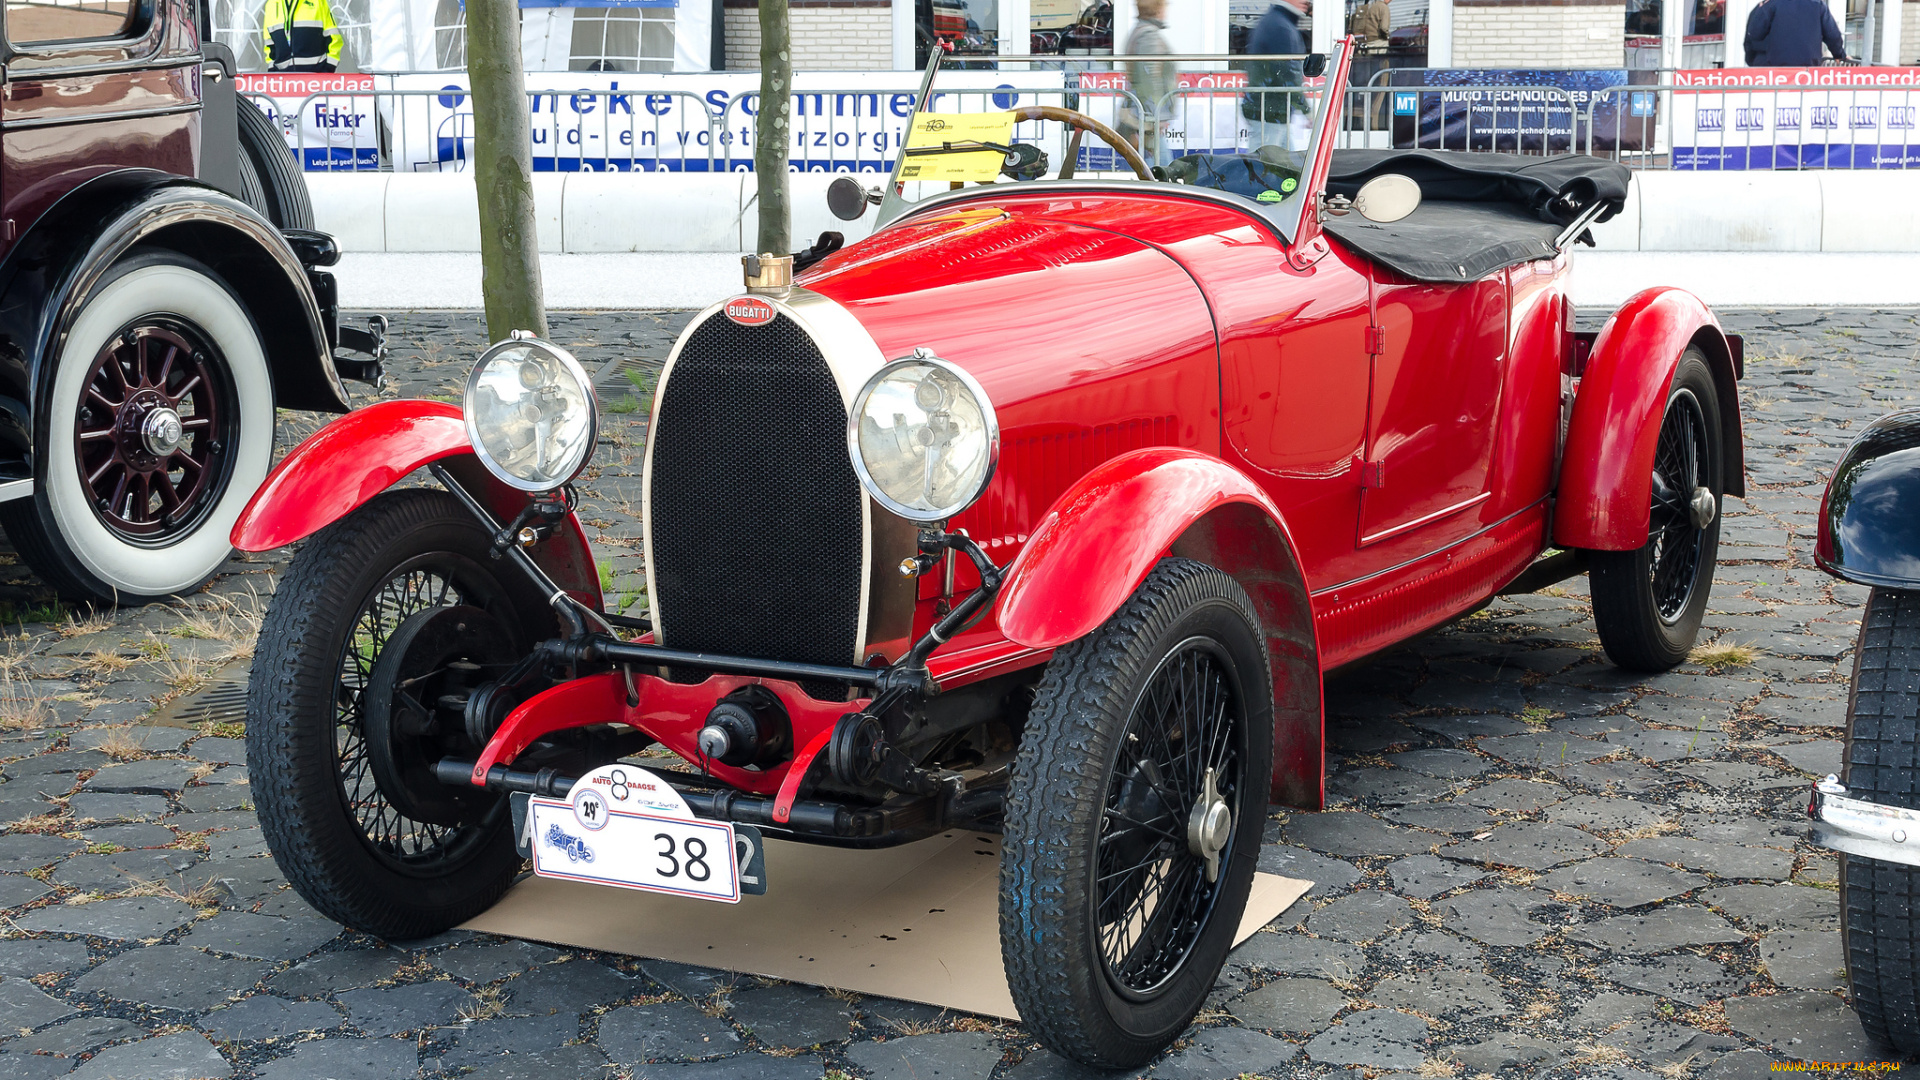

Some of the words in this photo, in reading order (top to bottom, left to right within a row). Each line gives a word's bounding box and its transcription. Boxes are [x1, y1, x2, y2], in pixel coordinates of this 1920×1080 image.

[1676, 70, 1788, 86] Nationale
[1795, 69, 1920, 86] Oldtimerda
[532, 82, 674, 116] neke
[1396, 97, 1416, 111] MT
[315, 103, 366, 128] Fisher
[532, 124, 599, 145] uid-
[619, 130, 656, 146] en
[312, 159, 338, 167] Lelysad
[728, 304, 771, 320] BUGATTI
[592, 777, 612, 786] AUTO
[627, 781, 657, 792] DAAGSE
[653, 832, 712, 882] 38
